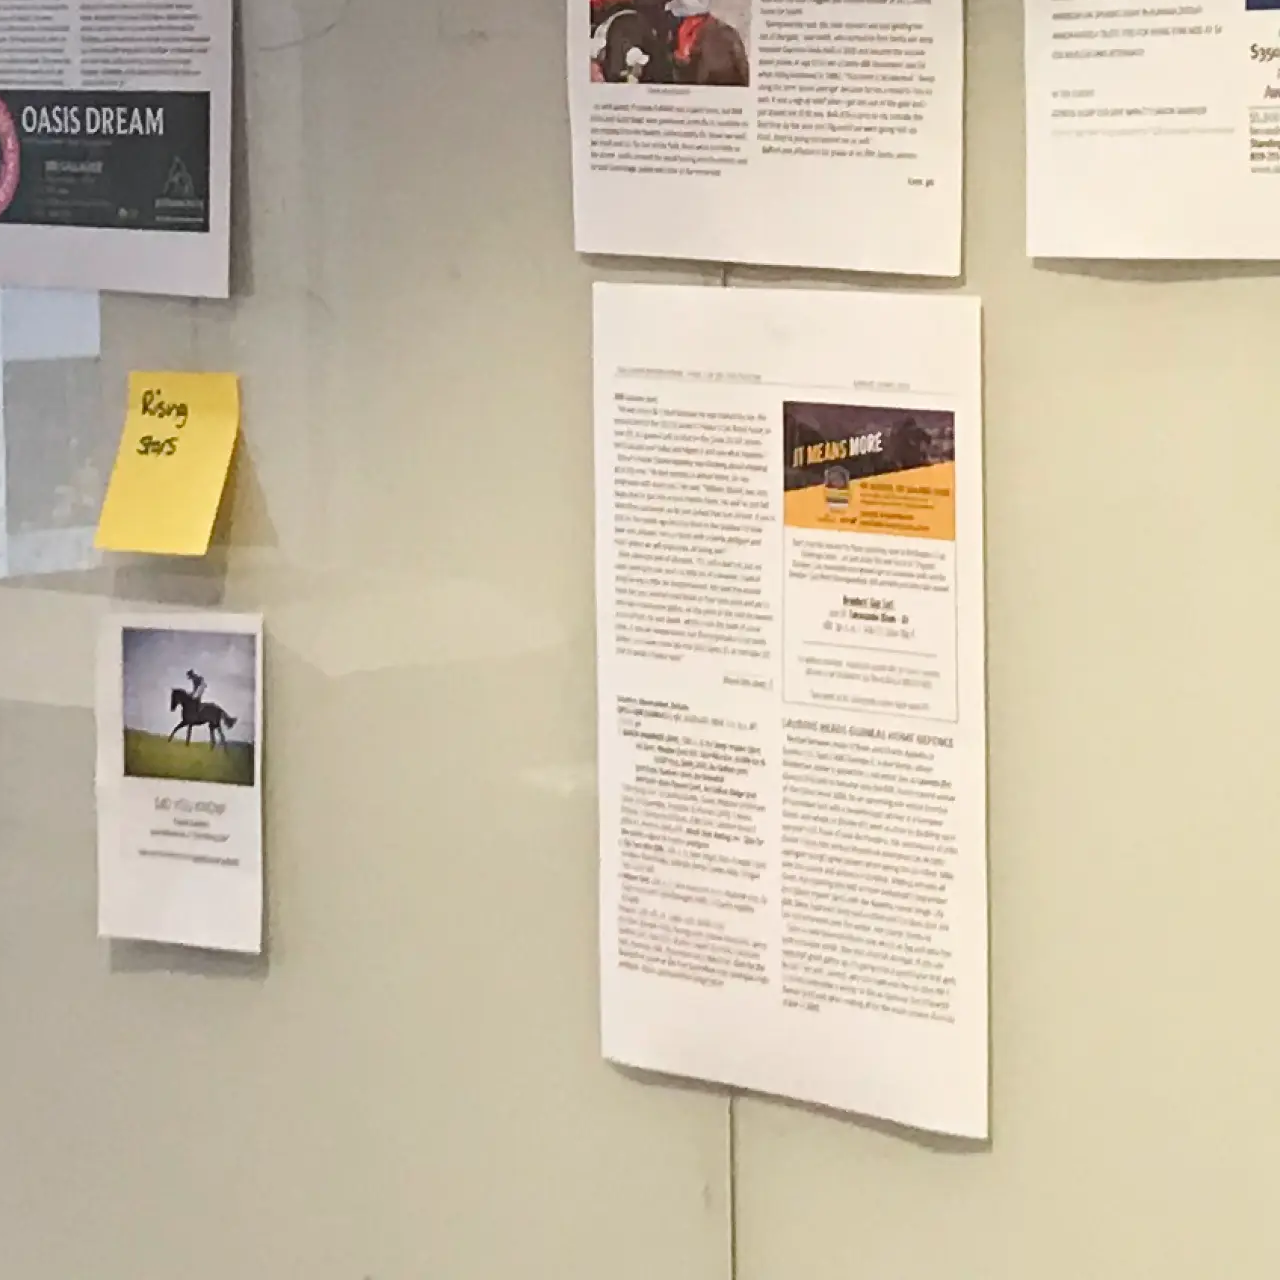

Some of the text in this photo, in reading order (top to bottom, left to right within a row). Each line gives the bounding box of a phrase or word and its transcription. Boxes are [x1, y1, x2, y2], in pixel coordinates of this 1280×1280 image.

[21, 105, 165, 137] OASIS DREAM
[141, 389, 188, 429] Rising
[806, 439, 847, 465] MEANS
[848, 431, 884, 457] MORE
